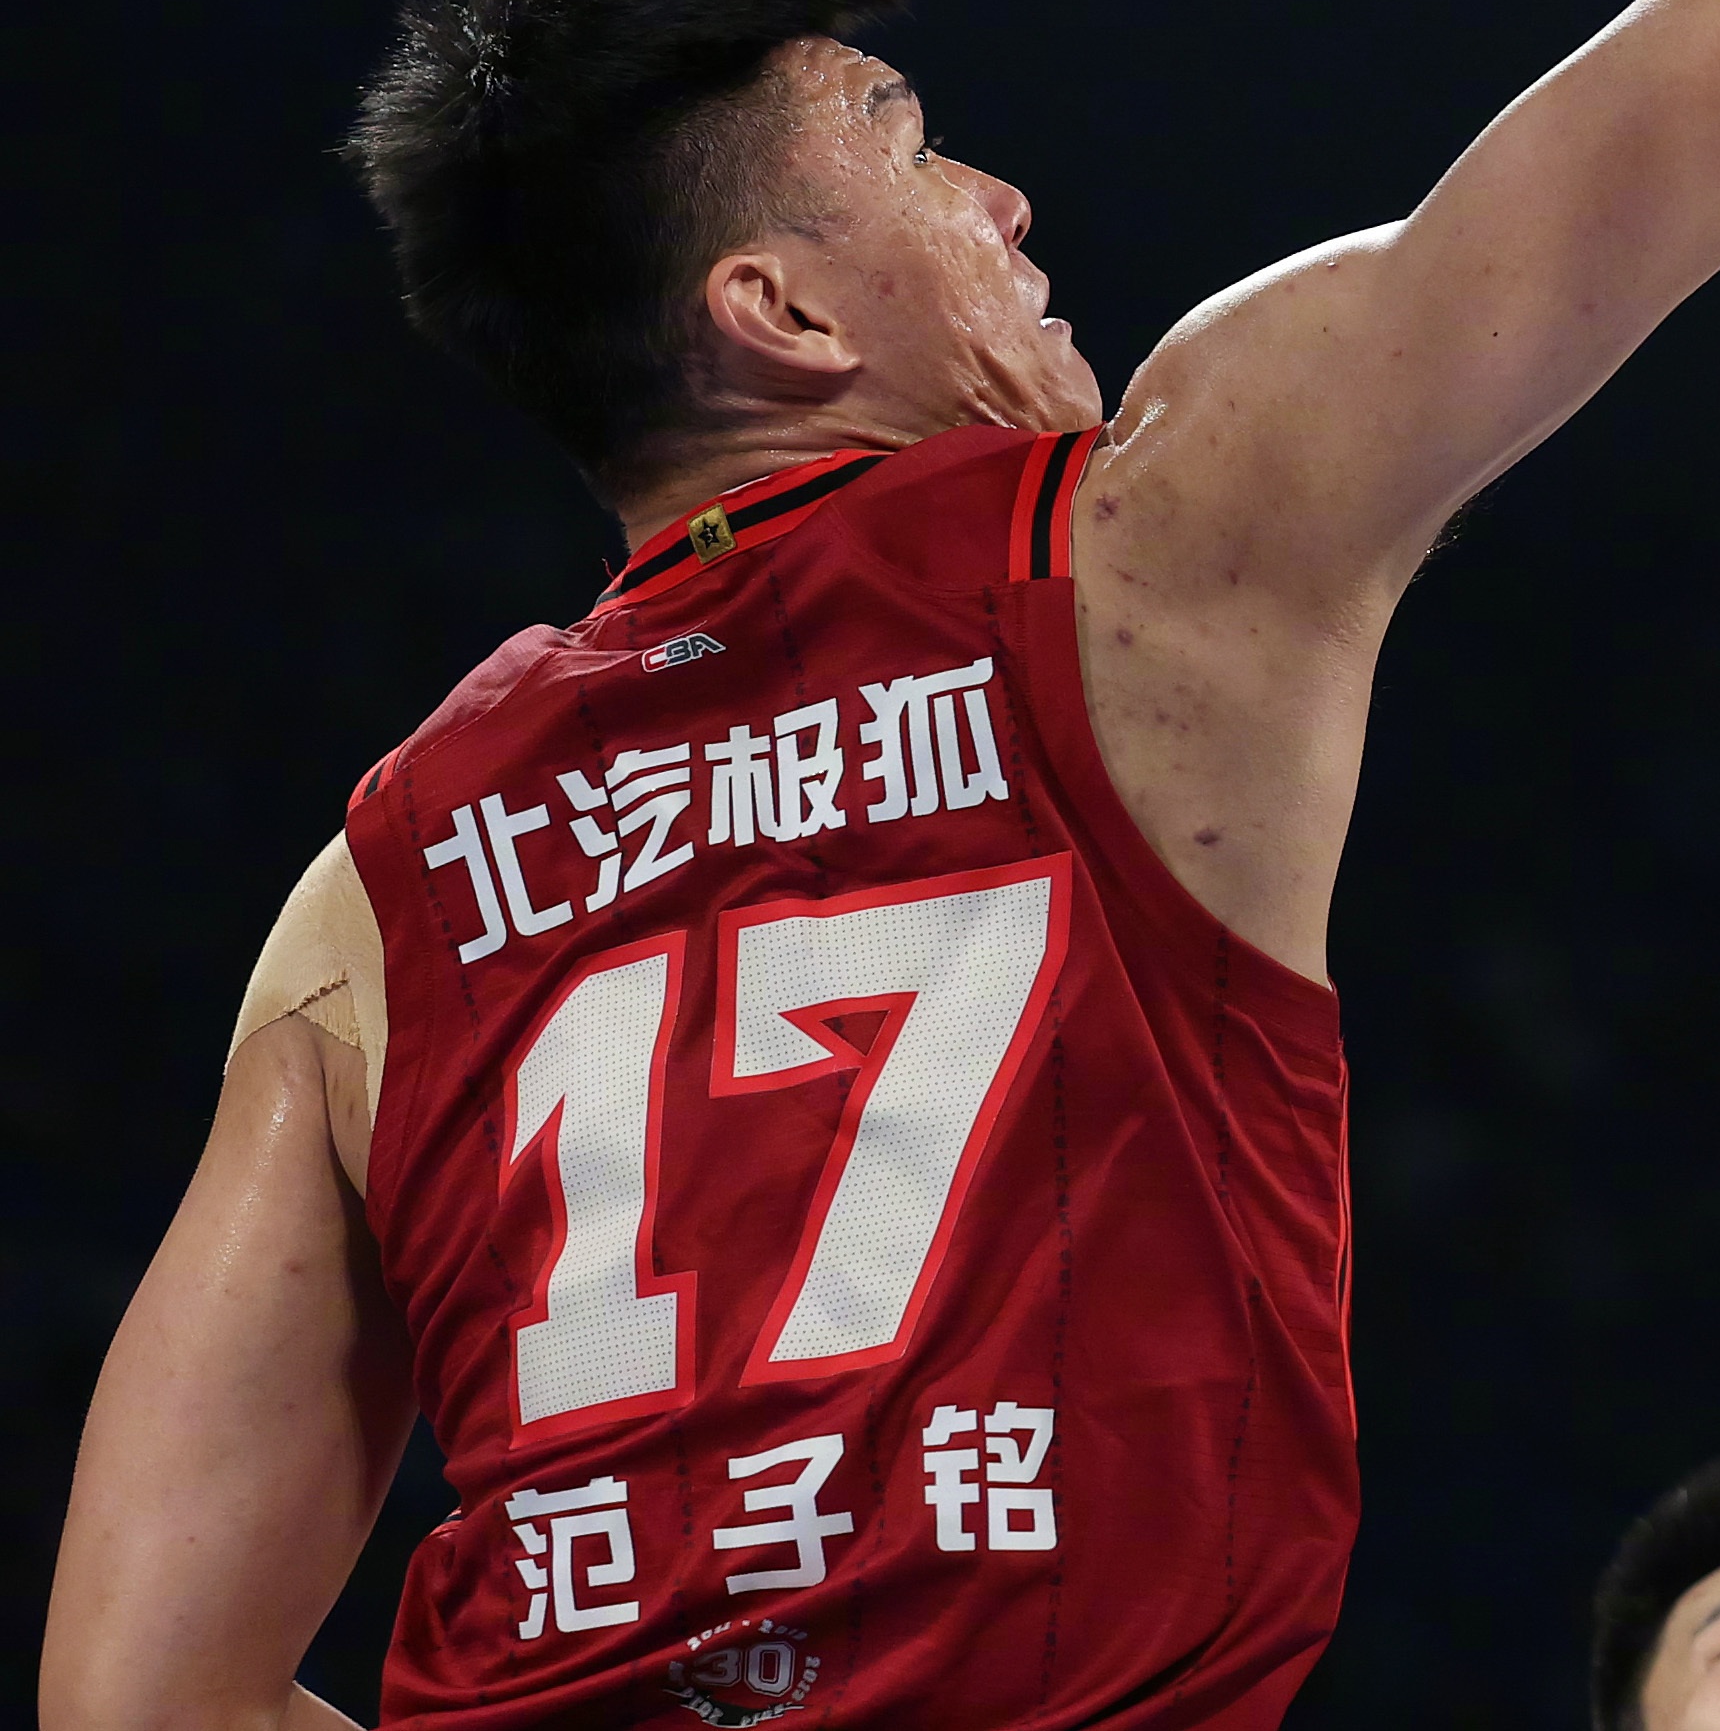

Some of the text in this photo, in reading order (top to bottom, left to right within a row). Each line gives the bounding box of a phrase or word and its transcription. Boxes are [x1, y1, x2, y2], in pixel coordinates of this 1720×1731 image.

[641, 632, 727, 673] CBA
[424, 657, 1009, 965] 北汽极狐
[500, 852, 1071, 1448] 17
[504, 1400, 1058, 1641] 范子铭
[692, 1641, 796, 1698] 30
